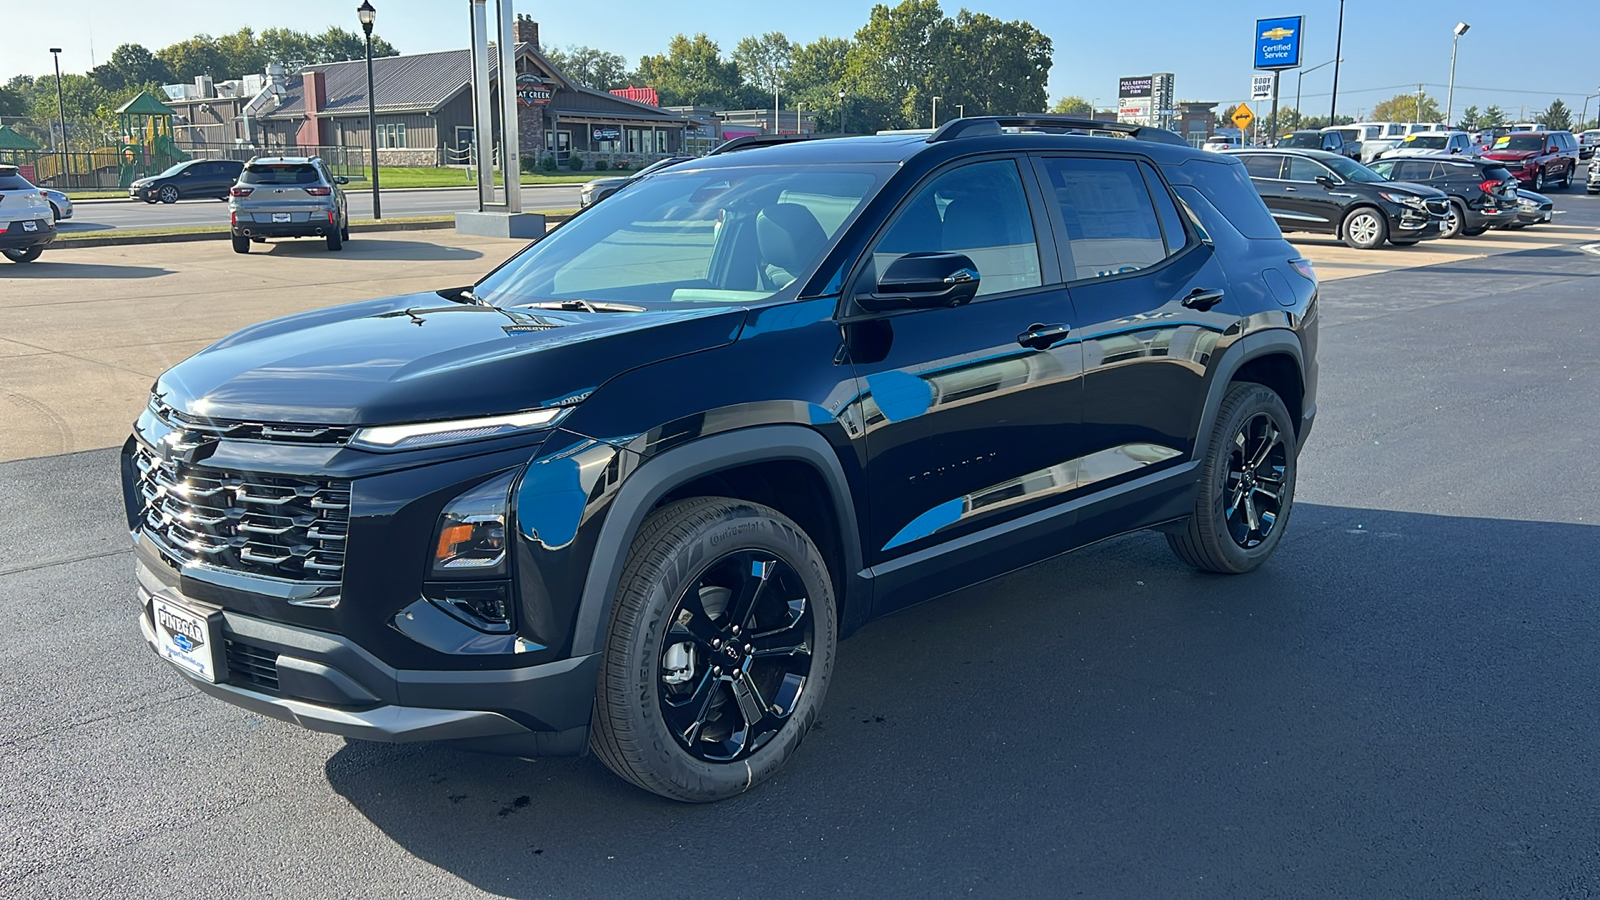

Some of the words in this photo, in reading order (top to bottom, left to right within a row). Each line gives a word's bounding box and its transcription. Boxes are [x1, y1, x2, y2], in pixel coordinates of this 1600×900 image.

[1262, 43, 1291, 52] Certified
[1253, 84, 1271, 92] SHOP
[529, 91, 550, 99] CREEK
[1153, 75, 1162, 121] WILDWOOD
[159, 608, 204, 644] PINEGAR
